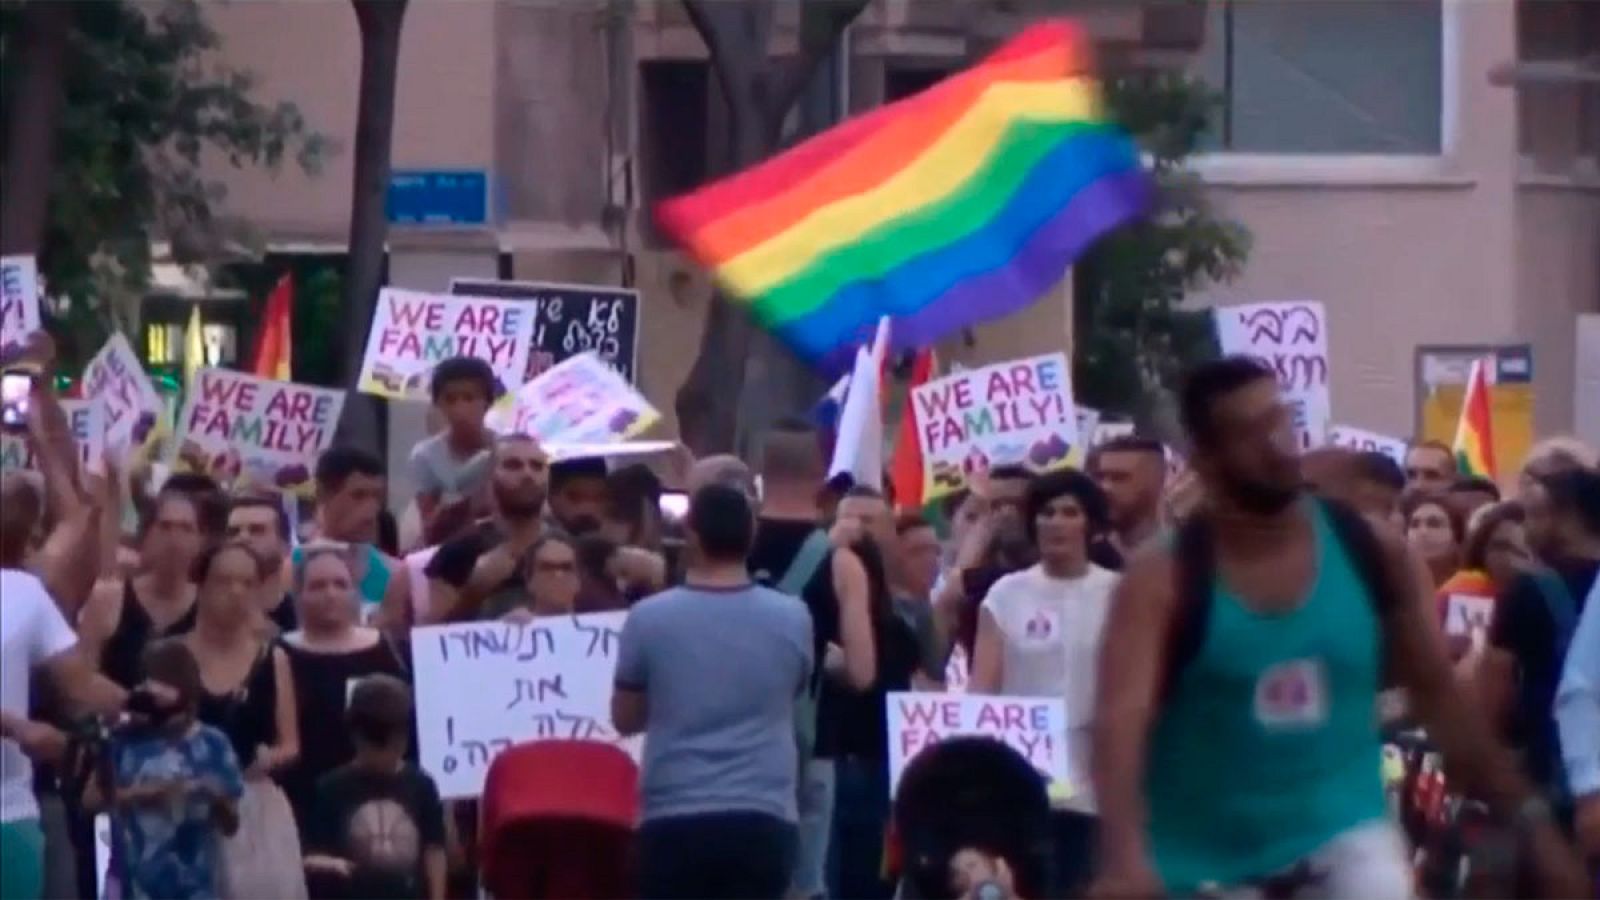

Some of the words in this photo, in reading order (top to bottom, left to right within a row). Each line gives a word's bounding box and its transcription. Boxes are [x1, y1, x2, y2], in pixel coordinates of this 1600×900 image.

[389, 297, 445, 331] WE
[455, 304, 520, 336] ARE
[202, 374, 258, 412] WE
[265, 388, 333, 422] ARE
[917, 377, 973, 419] WE
[987, 361, 1058, 401] ARE
[190, 404, 323, 451] FAMILY!
[926, 392, 1066, 453] FAMILY!
[899, 700, 961, 728] WE
[976, 703, 1049, 731] ARE
